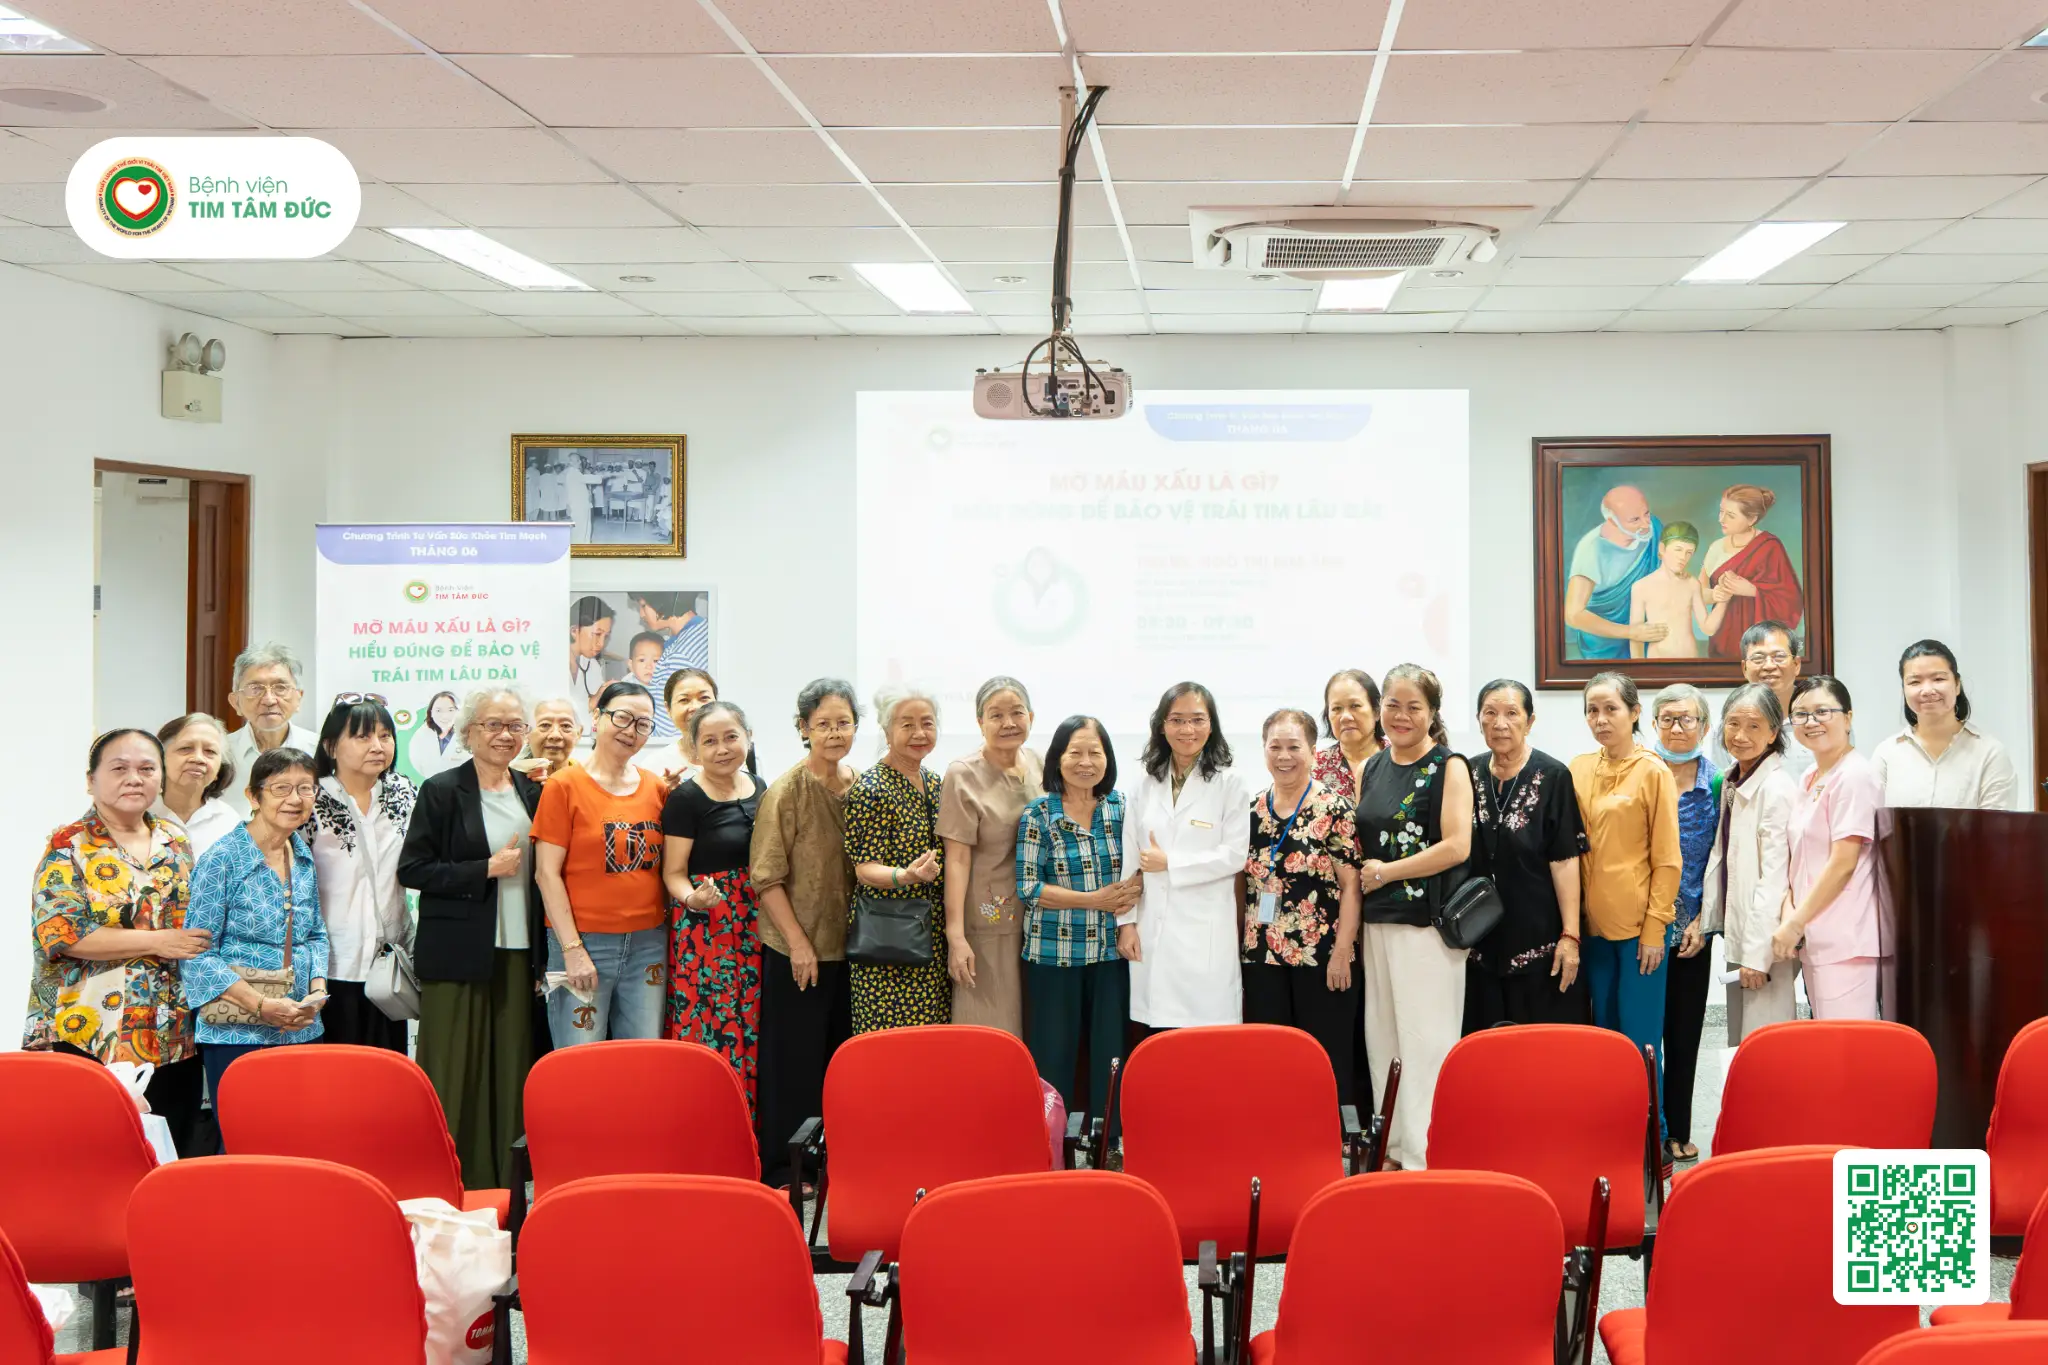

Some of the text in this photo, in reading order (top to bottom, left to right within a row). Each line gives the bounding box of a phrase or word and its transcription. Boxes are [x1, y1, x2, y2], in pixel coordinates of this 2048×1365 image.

[1095, 468, 1147, 491] MÁU
[1154, 467, 1200, 491] XẤU
[1253, 502, 1290, 519] TIM
[500, 532, 517, 540] Tim
[410, 544, 478, 557] THÁNG 06
[353, 616, 531, 635] MỠ MÁU XẤU LÀ GÌ?
[349, 638, 540, 660] HIỂU ĐÚNG ĐỂ BẢO VỆ
[372, 665, 517, 683] TRÁI TIM LÂU DÀI
